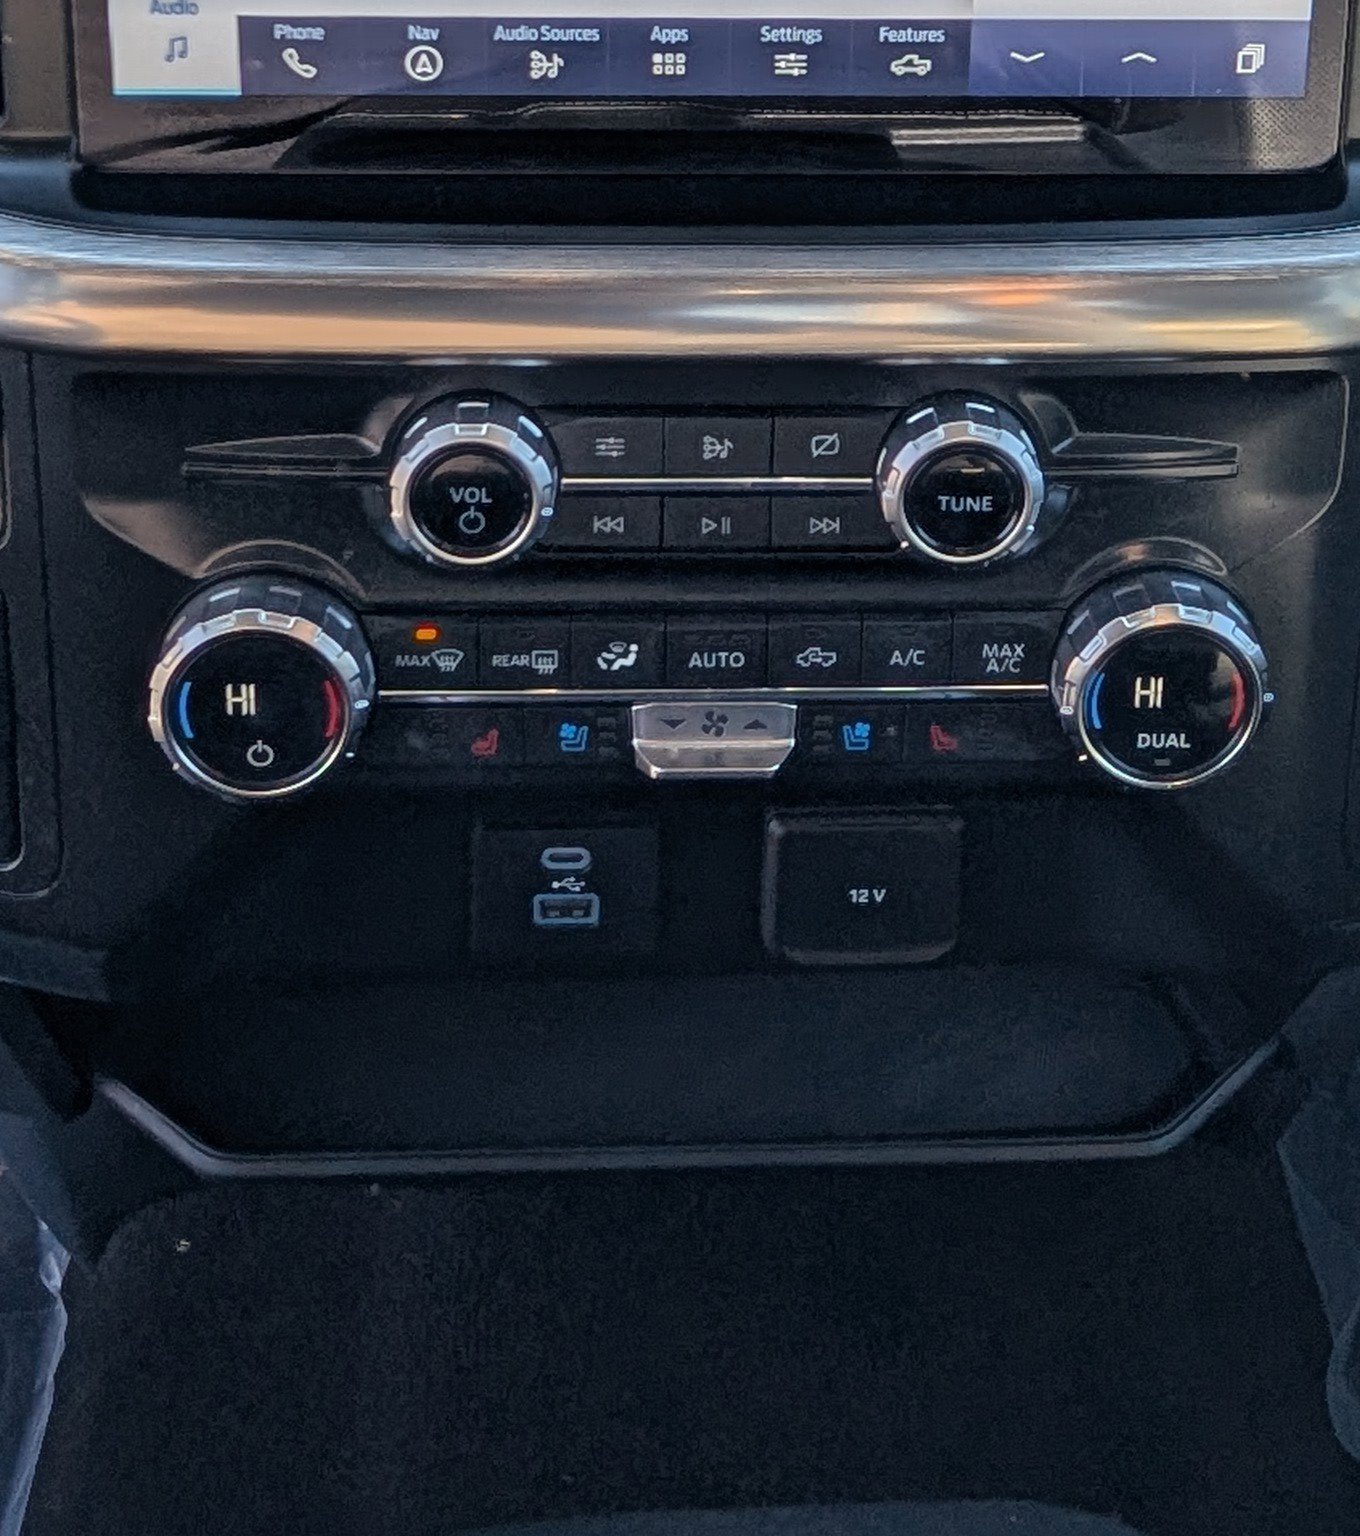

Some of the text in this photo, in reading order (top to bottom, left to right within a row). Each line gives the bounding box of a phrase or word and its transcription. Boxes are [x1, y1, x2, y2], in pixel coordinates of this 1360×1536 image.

[273, 23, 325, 42] Phone
[407, 24, 439, 41] Nav
[494, 23, 600, 42] Audio Sources
[650, 24, 689, 44] Apps
[760, 25, 823, 45] Settings
[878, 26, 946, 43] Features
[450, 486, 492, 505] VOL
[938, 495, 994, 513] TUNE
[890, 648, 926, 667] A/C
[982, 642, 1026, 659] MAX
[395, 654, 431, 669] MAX
[492, 654, 530, 669] REAR
[688, 651, 745, 669] AUTO
[986, 658, 1021, 674] A/C
[225, 683, 256, 716] HI
[1134, 677, 1164, 710] HI
[1136, 733, 1191, 750] DUAL
[849, 888, 887, 904] 12 V
